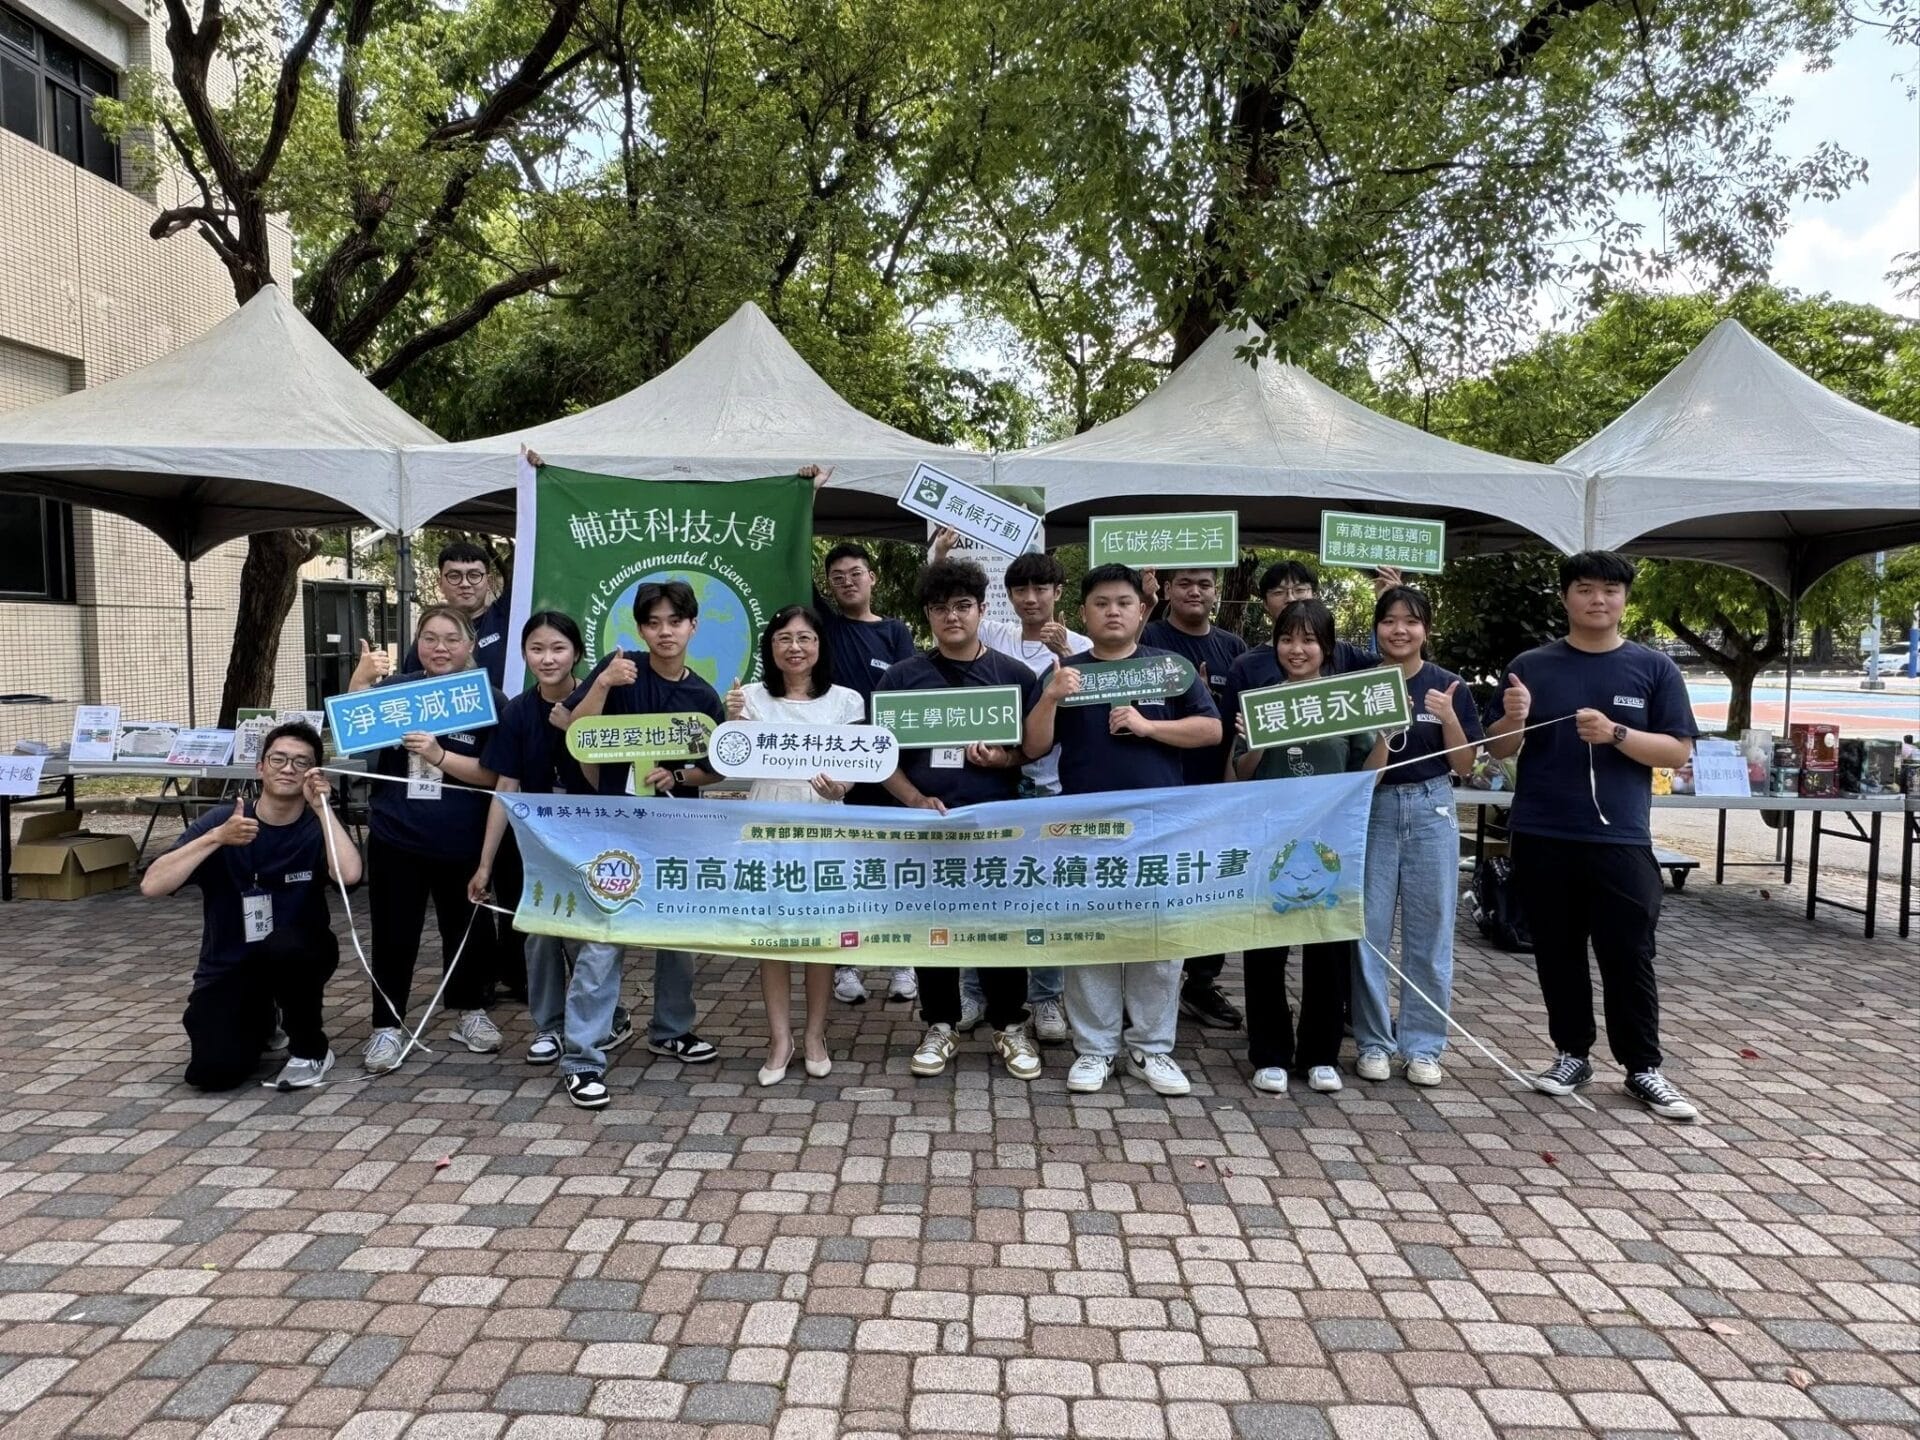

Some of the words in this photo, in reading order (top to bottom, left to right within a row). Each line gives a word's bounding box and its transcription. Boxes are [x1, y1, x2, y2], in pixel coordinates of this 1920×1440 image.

[568, 507, 776, 551] 輔英科技大學
[945, 495, 1022, 543] 氣候行動
[1100, 526, 1225, 553] 低碳綠生活
[1335, 522, 1432, 545] 南高雄地區邁向
[1328, 541, 1438, 565] 環境永續發展計畫
[599, 550, 708, 596] Environmental
[709, 555, 752, 596] Science
[592, 593, 608, 615] of
[748, 598, 770, 628] and
[1079, 664, 1165, 691] 塑愛地球
[342, 683, 484, 737] 淨零減碳
[876, 706, 1016, 730] 環生學院USR
[1254, 682, 1398, 733] 環境永續
[578, 726, 688, 748] 減塑愛地球
[756, 732, 892, 754] 輔英科技大學
[762, 754, 807, 770] Fooyin
[812, 756, 882, 773] University
[536, 806, 648, 819] 輔英科技大學
[597, 860, 632, 877] FYU
[655, 848, 1252, 893] 南高雄地區邁向環境永續發展計畫
[600, 878, 631, 892] USR
[656, 902, 771, 916] Environmental
[778, 902, 889, 916] Sustainability
[895, 900, 997, 913] Development
[1004, 901, 1060, 914] Project
[1066, 900, 1080, 911] in
[1087, 899, 1160, 911] Southern
[1167, 887, 1245, 908] Kaohsiung
